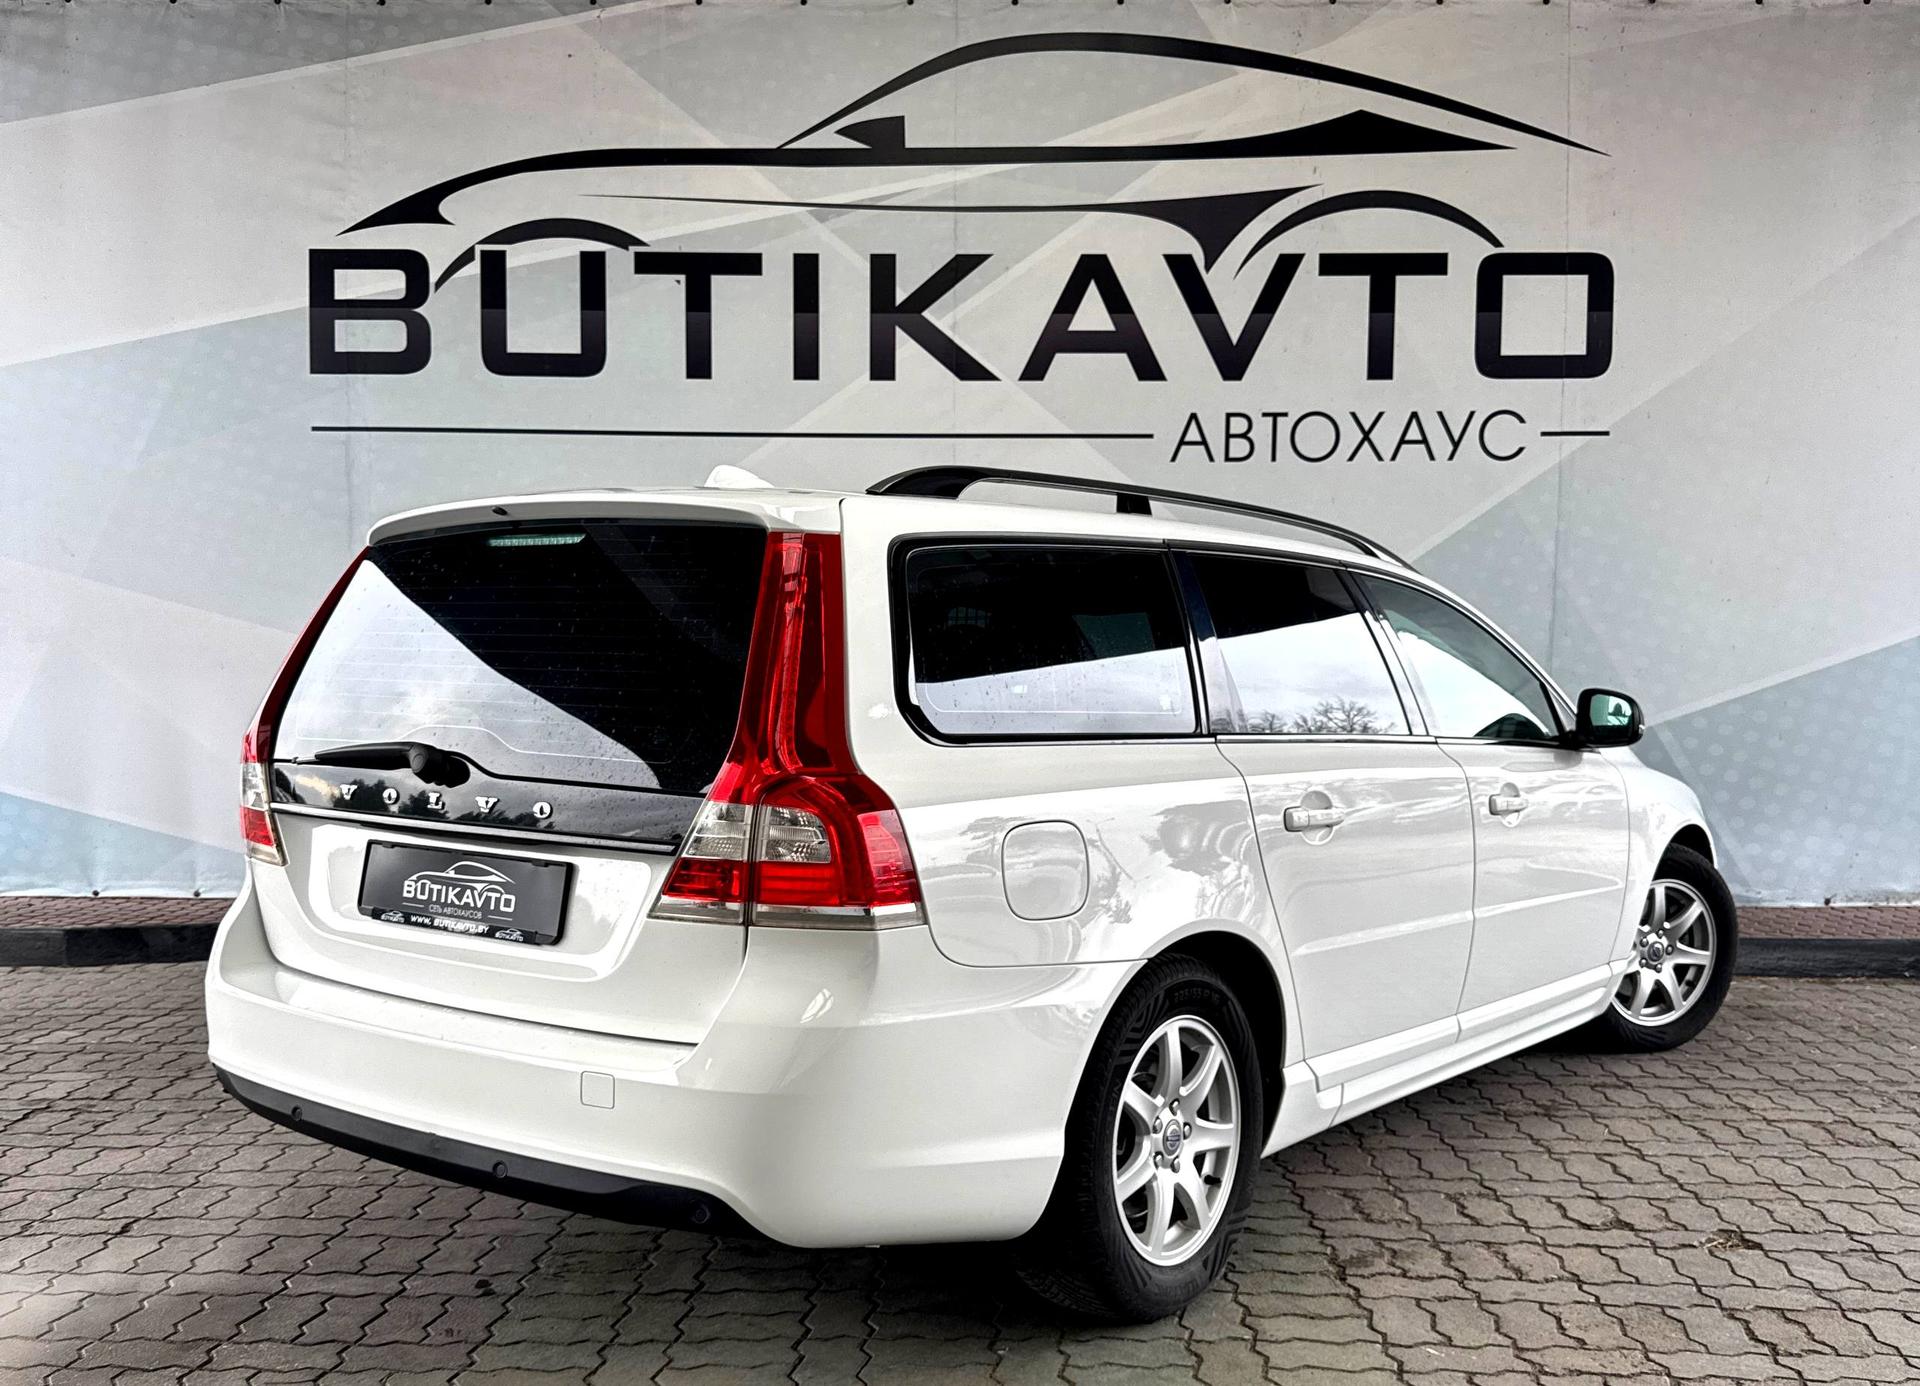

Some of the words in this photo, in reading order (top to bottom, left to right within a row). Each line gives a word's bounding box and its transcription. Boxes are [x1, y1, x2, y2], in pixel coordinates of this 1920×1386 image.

[308, 248, 1615, 382] BUTIKAVTO
[1169, 409, 1527, 463] АВТОХАУС
[339, 783, 553, 819] VOLVO
[402, 879, 516, 912] BUTIKAVTO
